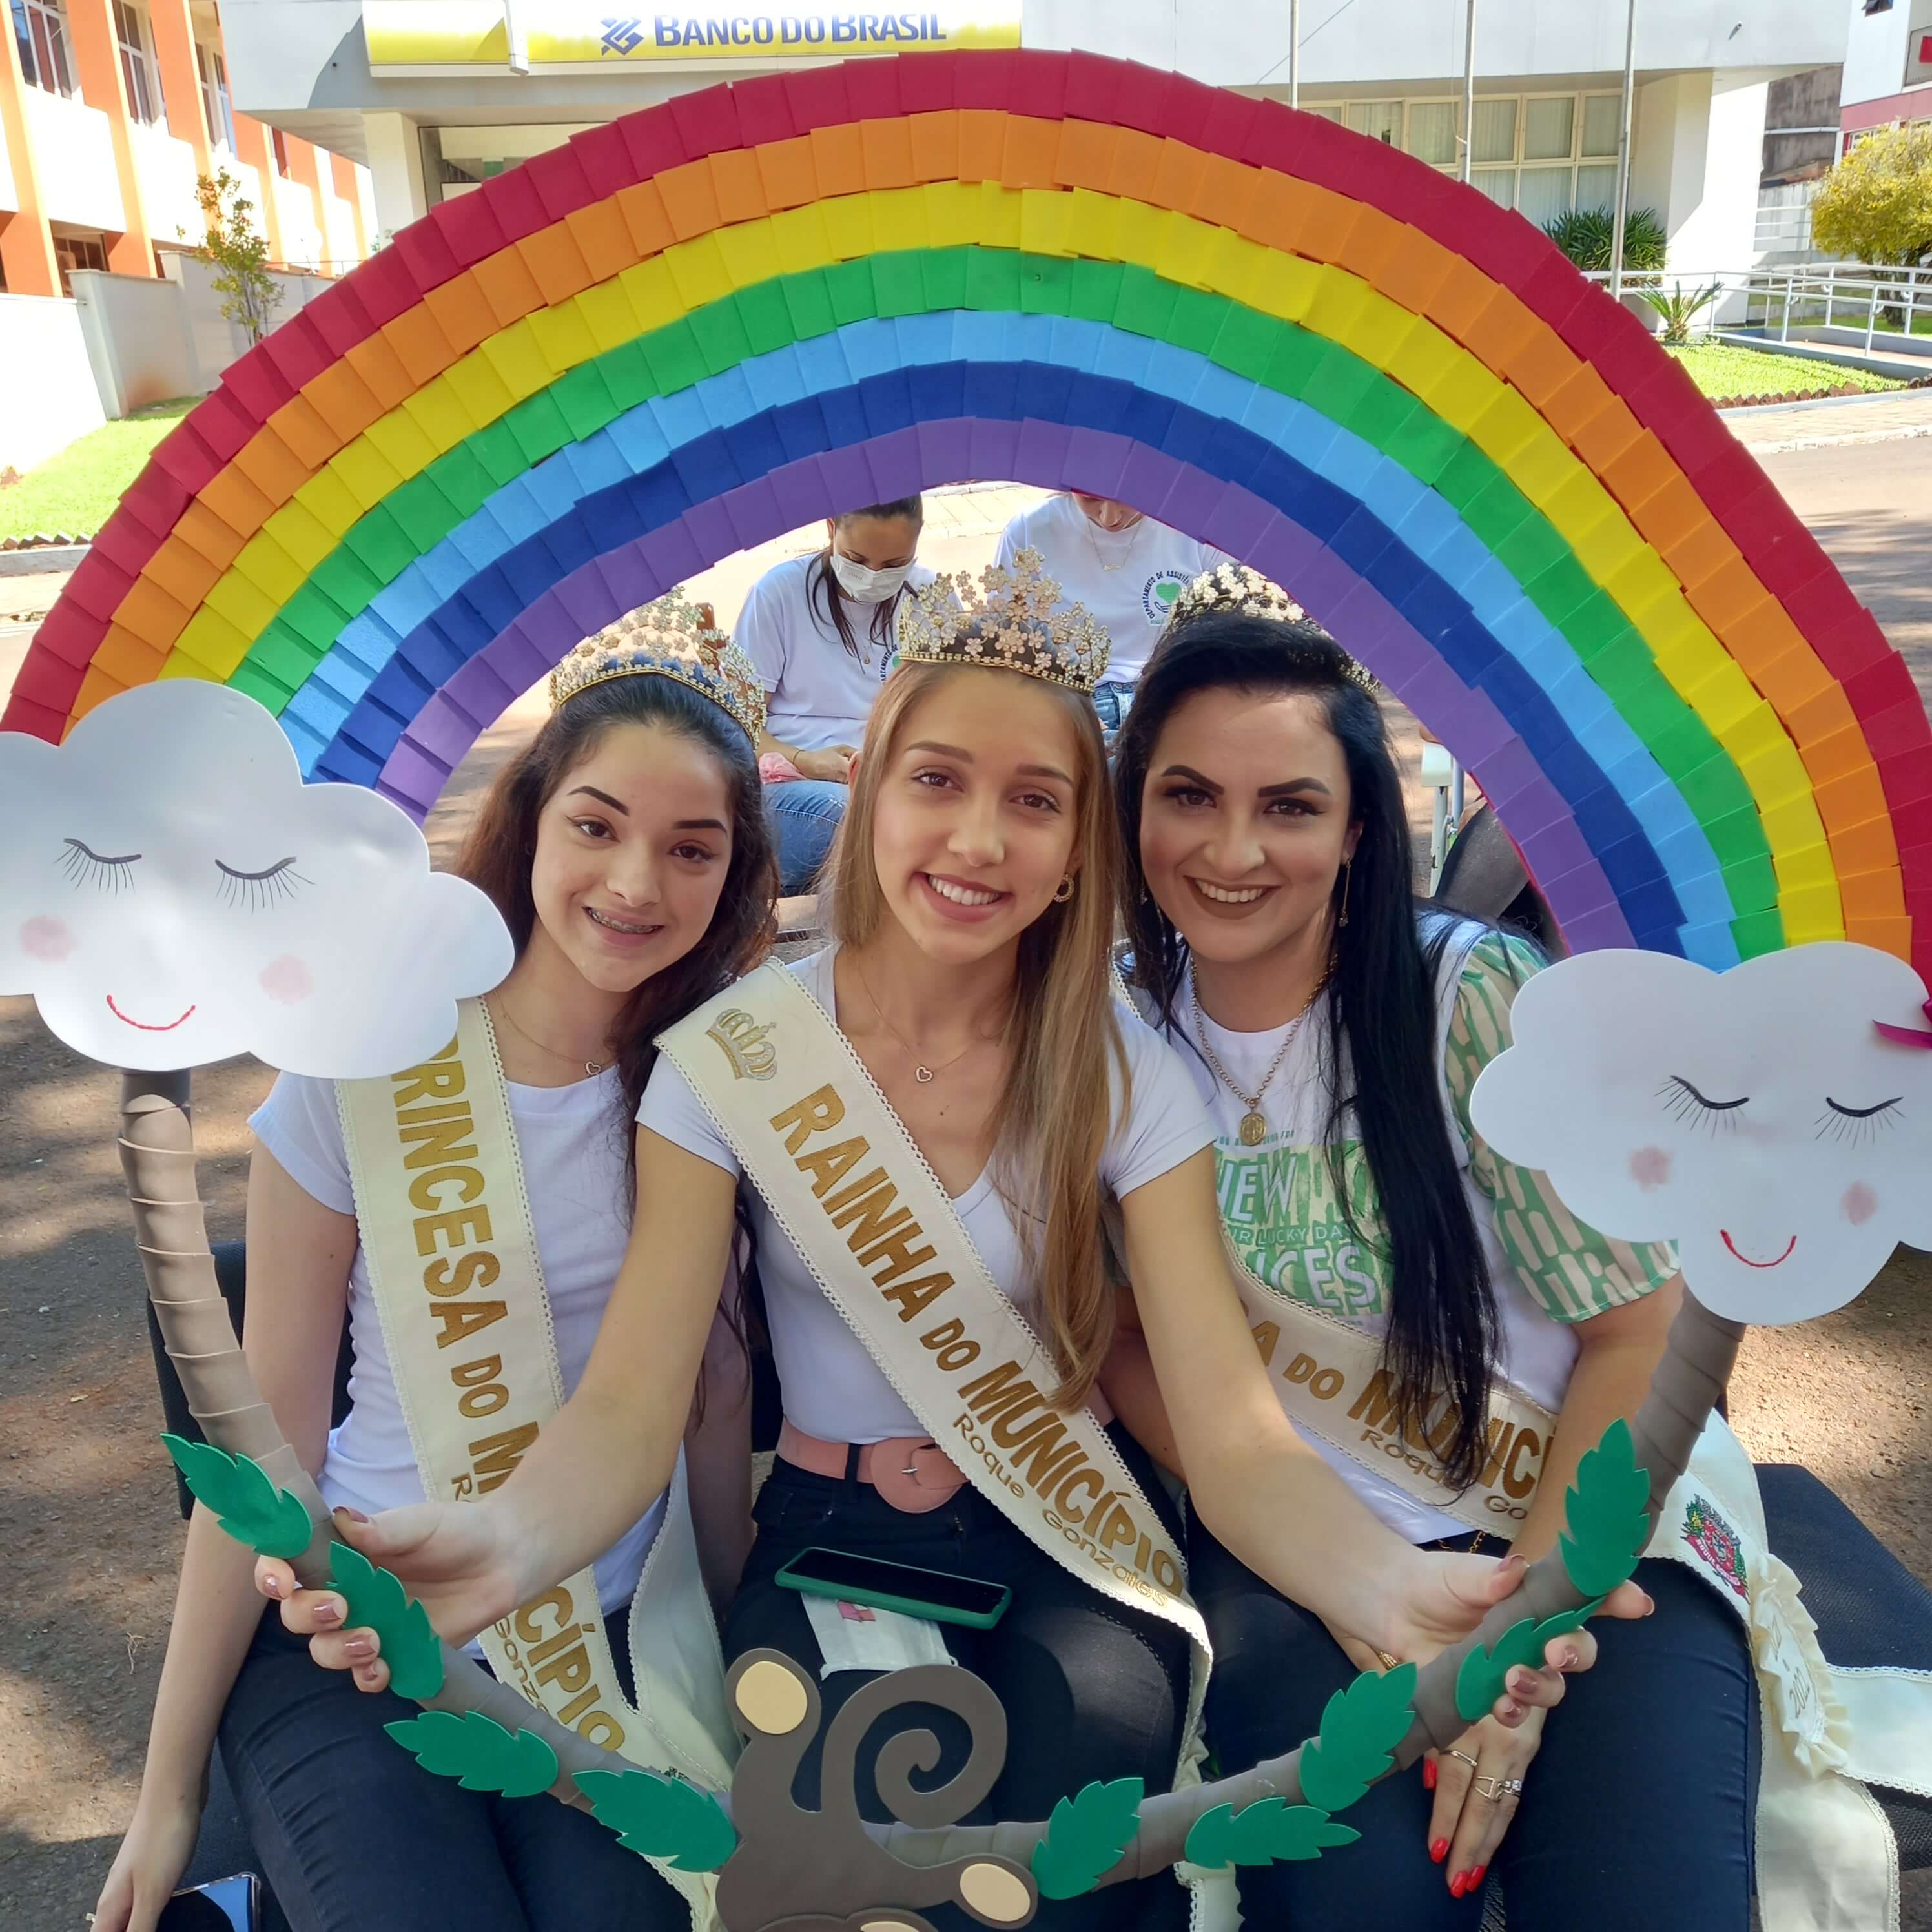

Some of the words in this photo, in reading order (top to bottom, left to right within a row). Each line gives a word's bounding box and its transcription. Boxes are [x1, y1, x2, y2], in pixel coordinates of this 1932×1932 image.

[655, 14, 774, 46] BANCO
[781, 16, 825, 44] DO
[832, 13, 947, 43] BRASIL
[1315, 1226, 1343, 1240] DA
[769, 1083, 955, 1322] RAINHA
[920, 1317, 981, 1372] DO
[957, 1360, 1184, 1597] MUNICÍPIO
[451, 1353, 509, 1419] DO
[1282, 1353, 1344, 1400] DO
[1360, 1429, 1454, 1486] Roqu
[953, 1413, 1025, 1499] Roque
[1042, 1508, 1169, 1608] Gonzales
